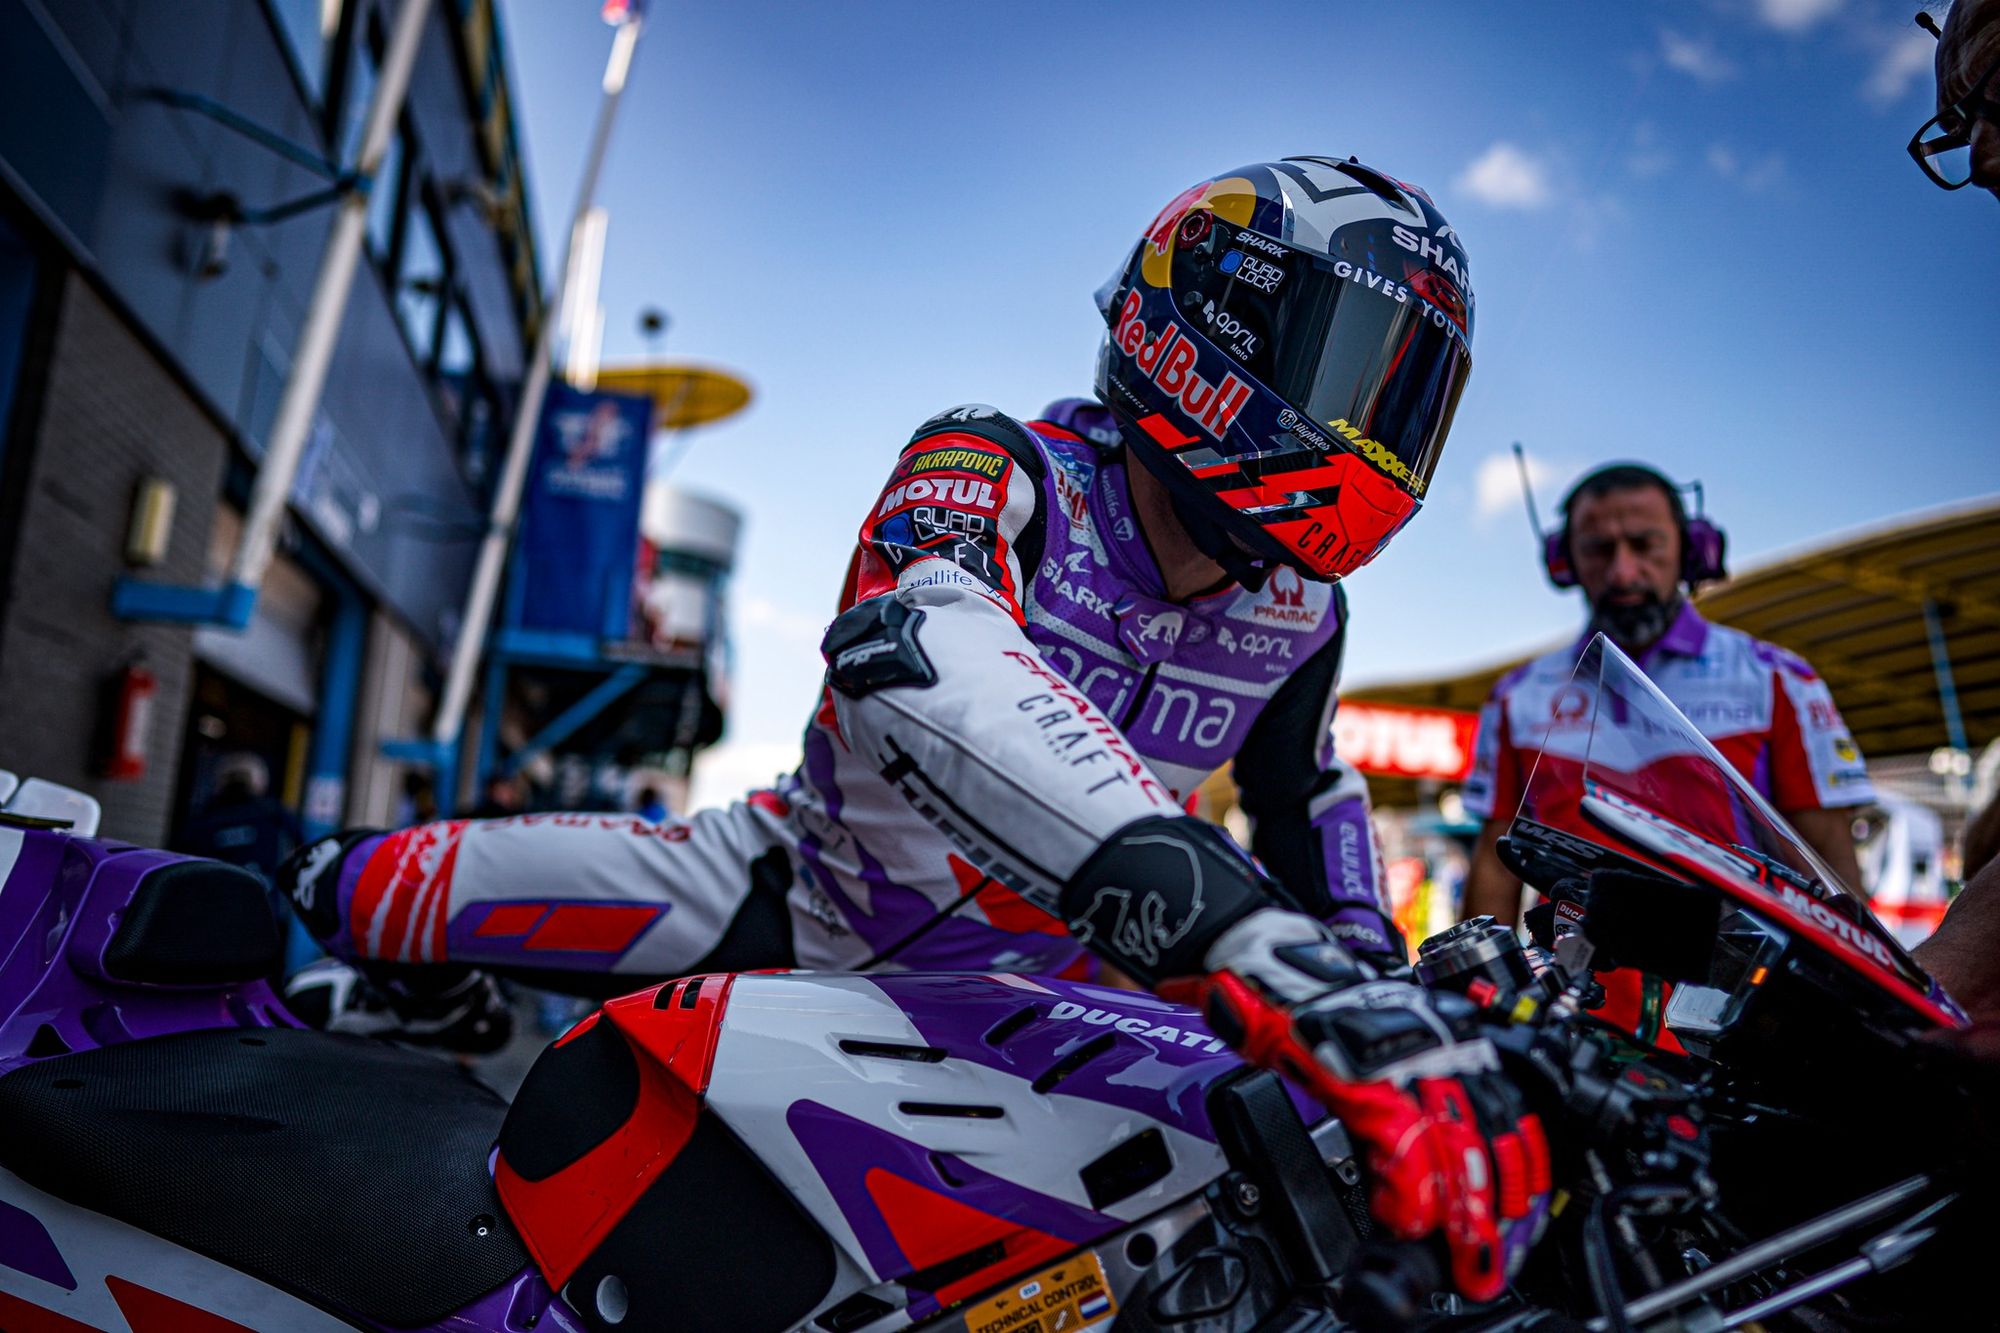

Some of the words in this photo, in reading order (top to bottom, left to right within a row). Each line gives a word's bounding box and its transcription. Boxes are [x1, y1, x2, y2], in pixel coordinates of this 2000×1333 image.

[1235, 231, 1289, 258] SHARK
[1235, 266, 1276, 292] LOCK
[1242, 256, 1283, 281] QUAD
[1333, 261, 1408, 303] GIVES
[1216, 312, 1257, 354] april
[1111, 286, 1180, 379] Red
[1153, 333, 1255, 442] Bull
[1230, 343, 1248, 361] Moto
[911, 450, 1003, 477] AKRAPOVIČ
[878, 479, 996, 518] MOTUL
[913, 507, 985, 534] QUAD
[1297, 521, 1363, 572] CRAF
[1254, 604, 1318, 625] PRAMAC
[1240, 633, 1293, 659] april
[1017, 693, 1129, 796] CRAFT
[1782, 885, 1891, 967] MOTUL
[1047, 1001, 1226, 1053] DUCATI
